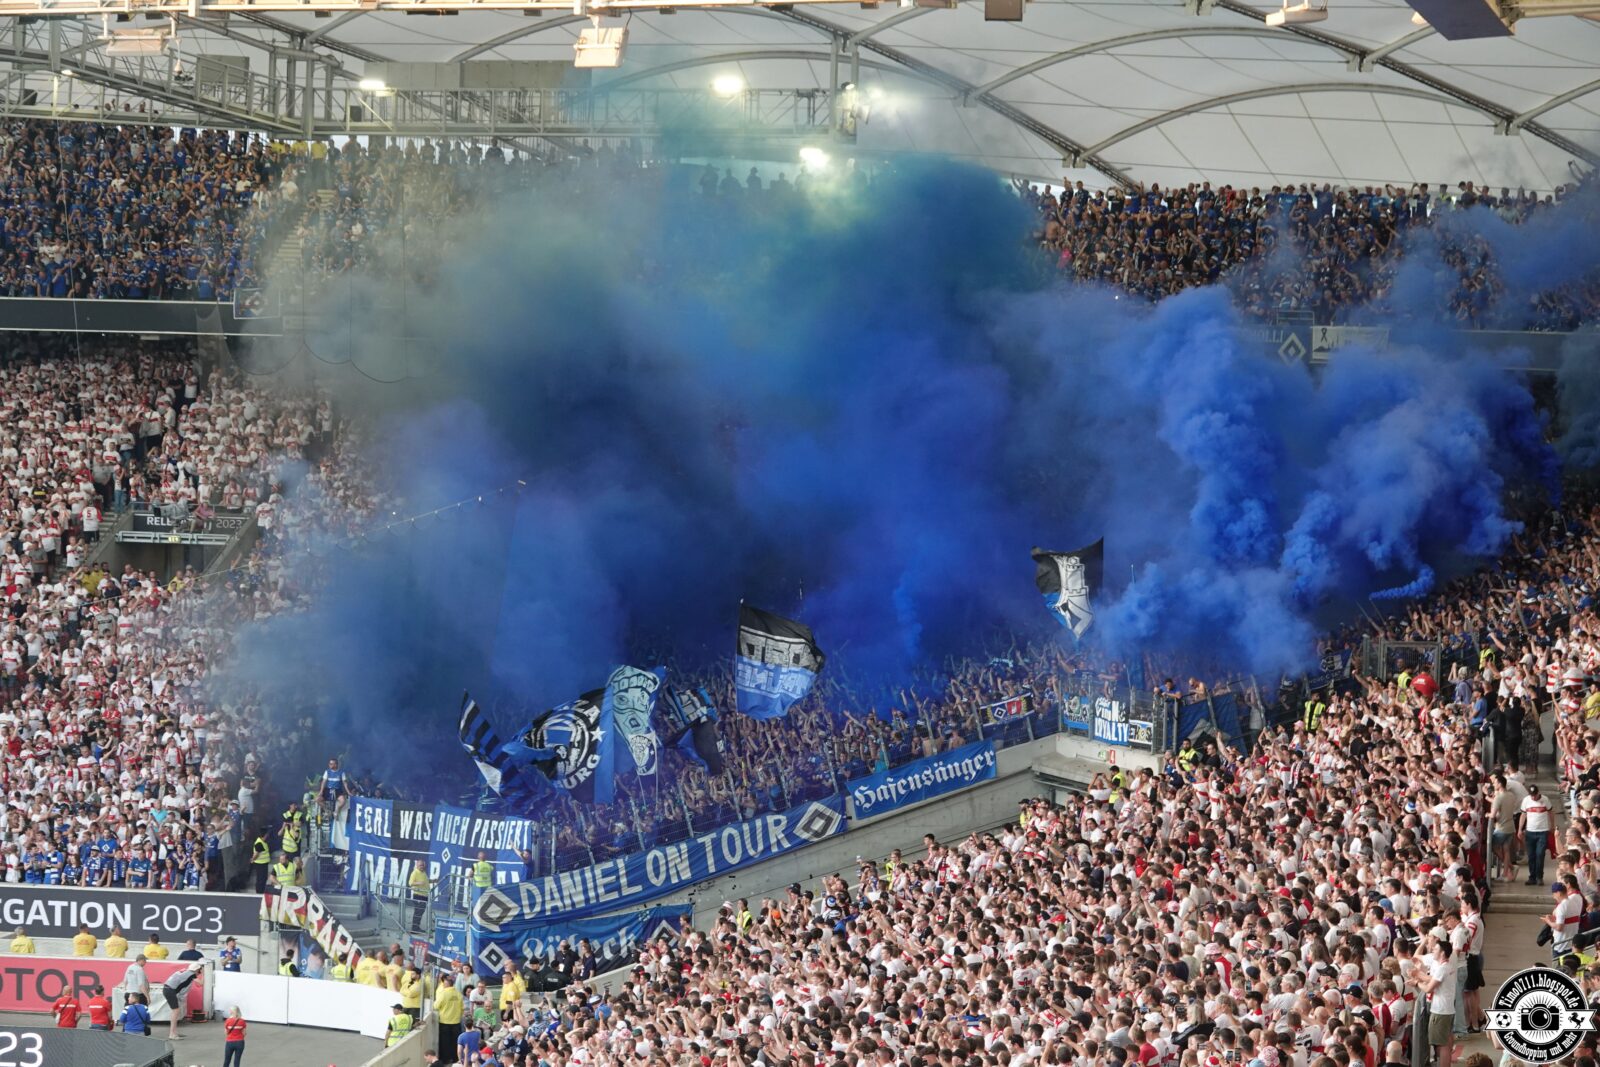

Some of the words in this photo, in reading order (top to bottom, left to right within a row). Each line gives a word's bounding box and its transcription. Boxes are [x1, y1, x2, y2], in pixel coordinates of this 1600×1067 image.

[215, 518, 242, 529] 2023
[355, 803, 392, 838] EGAL
[399, 809, 433, 841] WAS
[436, 811, 471, 847] AUCH
[470, 818, 531, 850] PASSIERT
[518, 858, 643, 920] DANIEL
[645, 845, 693, 886] ON
[700, 814, 792, 873] TOUR
[0, 898, 131, 929] GATION
[142, 904, 223, 933] 2023
